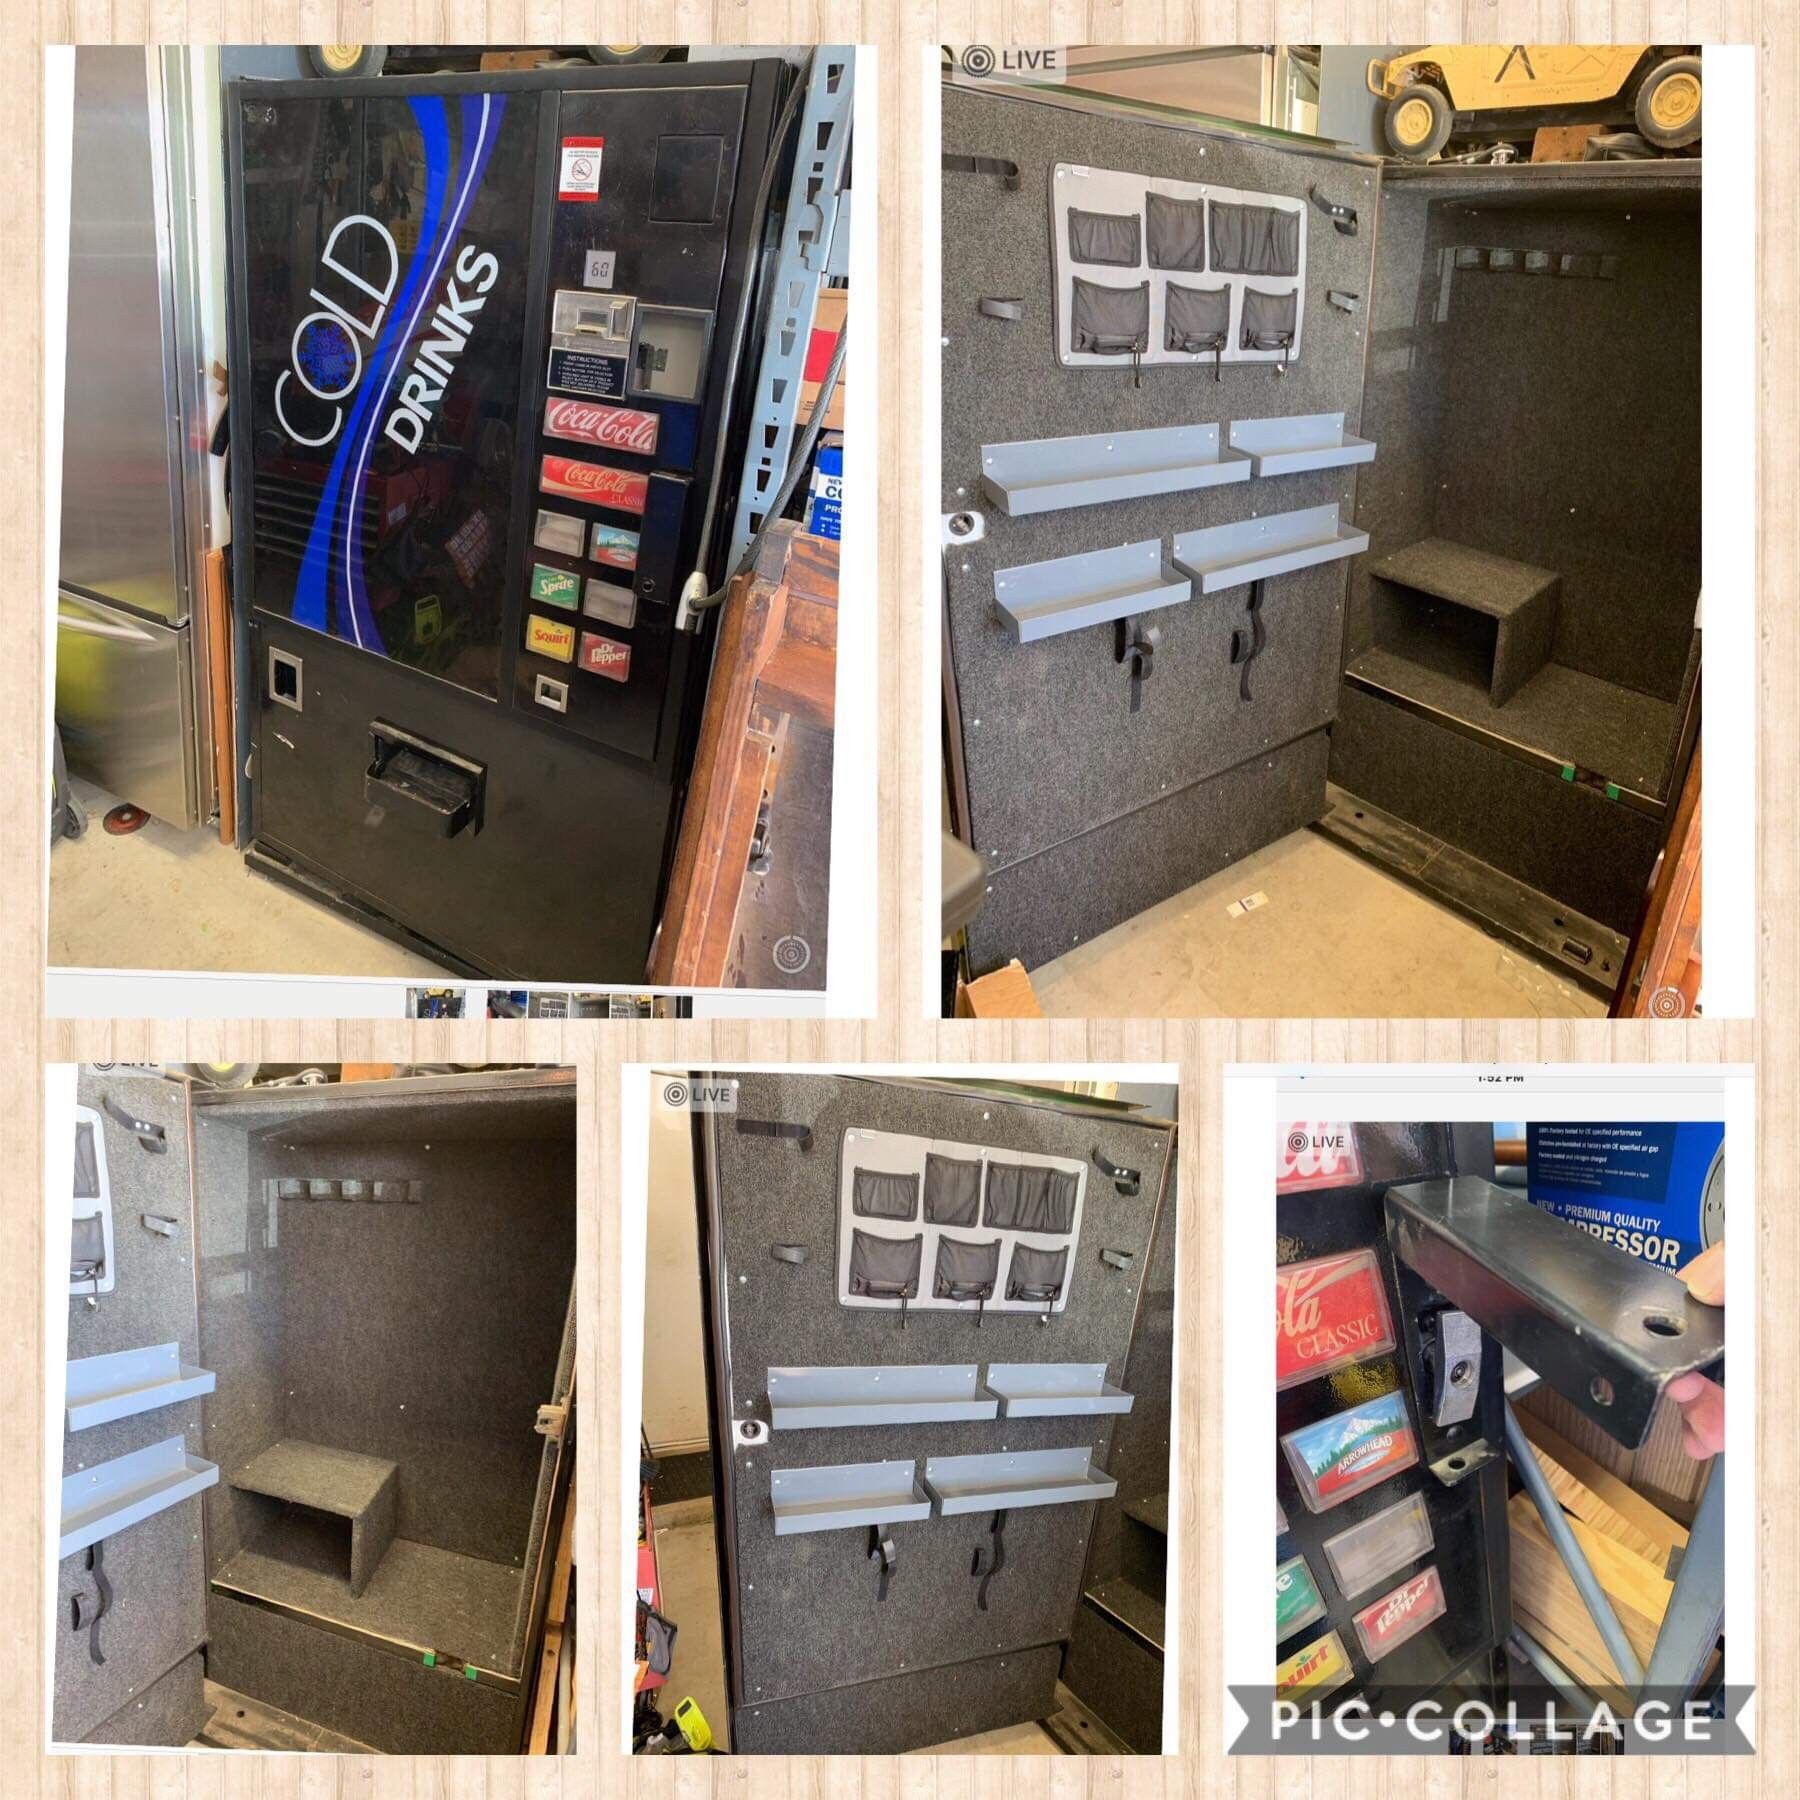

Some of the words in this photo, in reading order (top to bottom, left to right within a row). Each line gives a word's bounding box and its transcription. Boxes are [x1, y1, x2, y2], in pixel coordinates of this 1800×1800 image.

[591, 262, 609, 278] 60
[275, 214, 399, 447] COLD
[384, 244, 499, 455] DRINKS
[567, 354, 609, 366] INSTRUCTIONS
[540, 579, 574, 596] Sprite
[534, 628, 570, 645] Squirt
[591, 648, 626, 664] Pepper
[601, 643, 614, 653] Dr
[1611, 1129, 1642, 1137] performance
[1619, 1144, 1641, 1152] specified
[1648, 1146, 1659, 1154] gap
[1536, 1200, 1555, 1213] NEW
[1565, 1204, 1611, 1223] PREMIUM
[1614, 1212, 1661, 1233] QUALITY
[1297, 1313, 1379, 1359] CLASSIC
[1337, 1434, 1393, 1476] ARROWHEAD
[1377, 1576, 1430, 1634] Pepper
[1388, 1588, 1410, 1610] Dr
